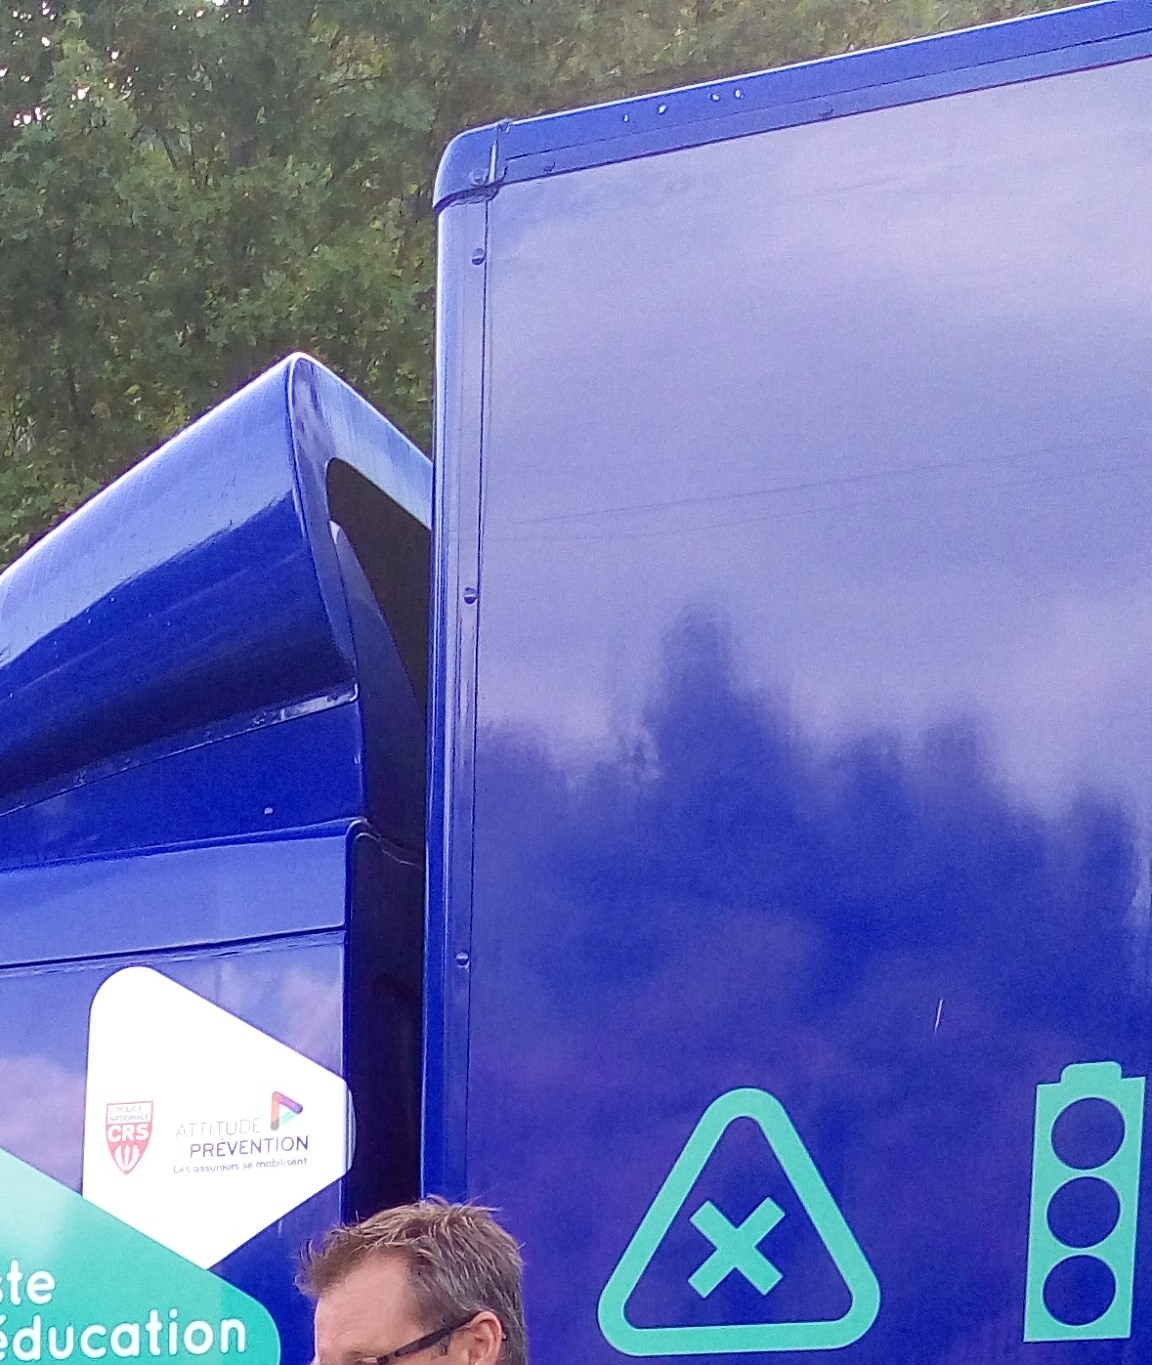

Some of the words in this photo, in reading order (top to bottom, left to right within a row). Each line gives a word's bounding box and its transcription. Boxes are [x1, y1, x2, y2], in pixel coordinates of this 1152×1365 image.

[107, 1123, 150, 1143] CRS
[175, 1117, 262, 1138] ATTITUDE
[189, 1135, 309, 1159] PRÉVENTION
